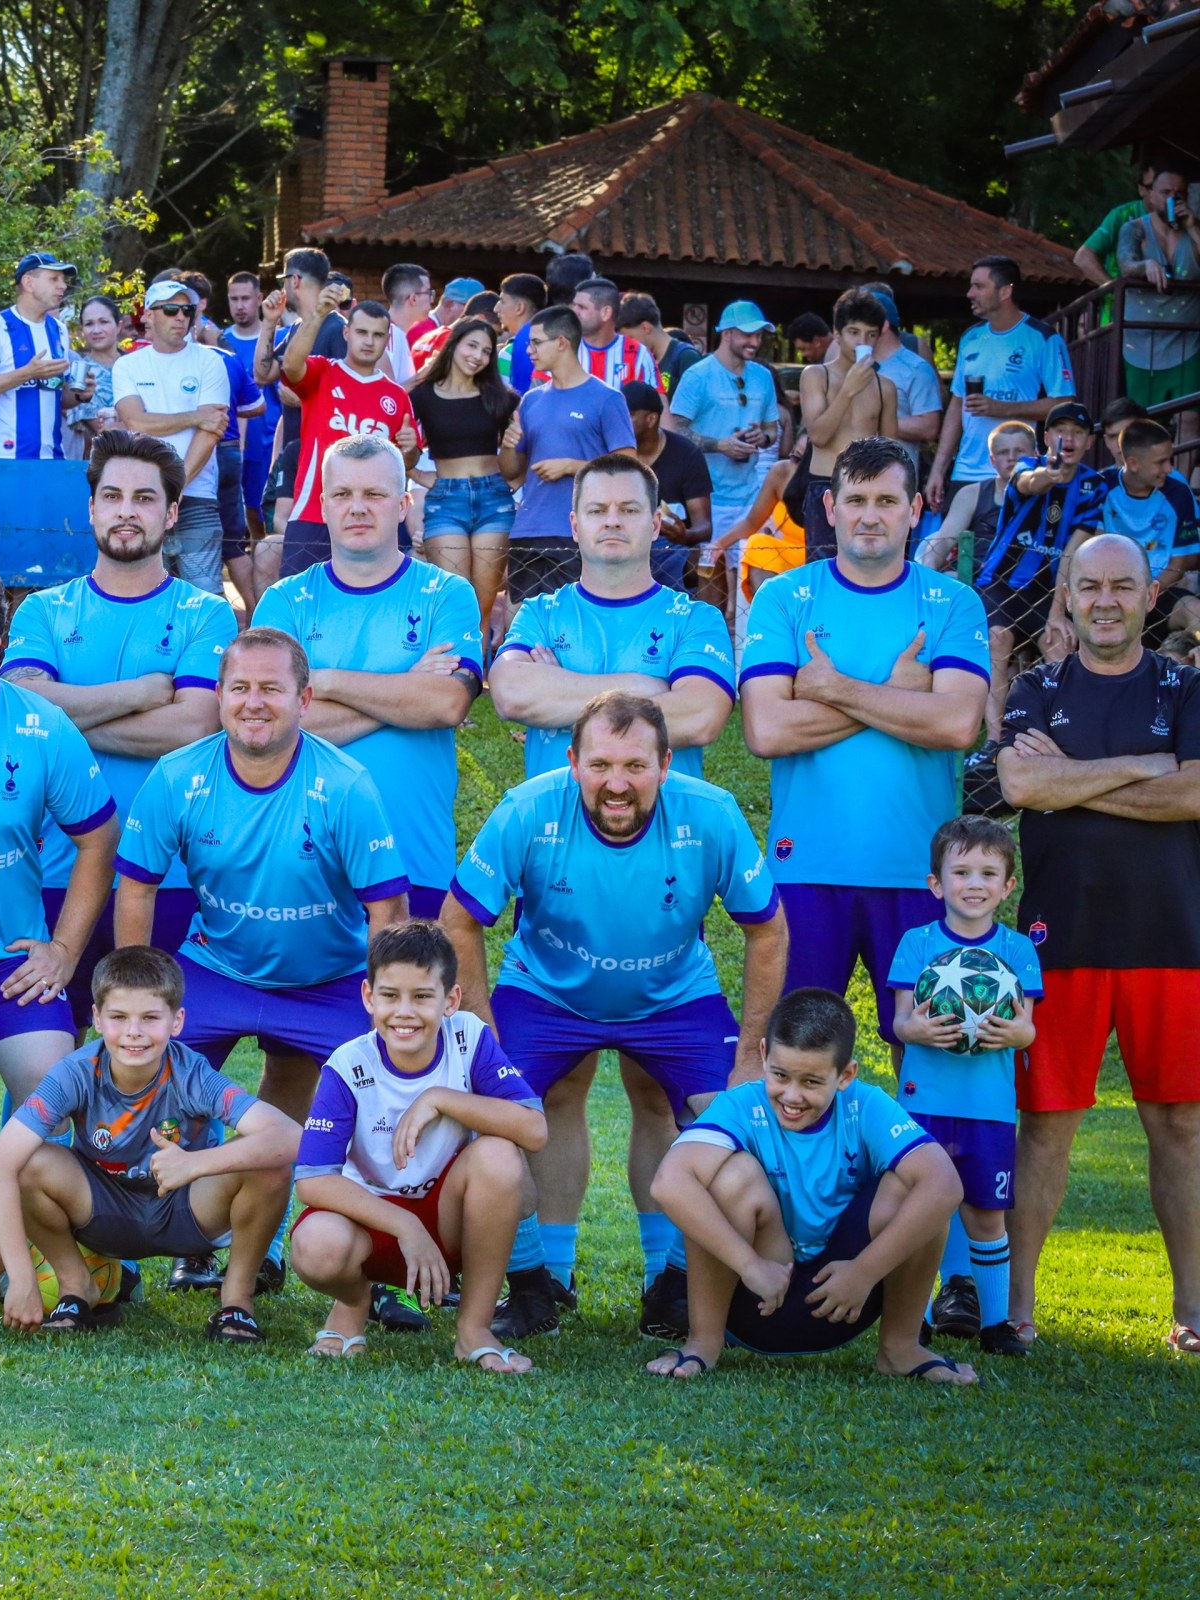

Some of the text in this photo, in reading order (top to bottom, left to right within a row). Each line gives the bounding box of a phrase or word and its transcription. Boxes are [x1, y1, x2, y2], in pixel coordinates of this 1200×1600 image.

[569, 411, 585, 420] FILA
[15, 724, 50, 738] imprima
[670, 838, 703, 850] imprima
[994, 1170, 1011, 1200] 21
